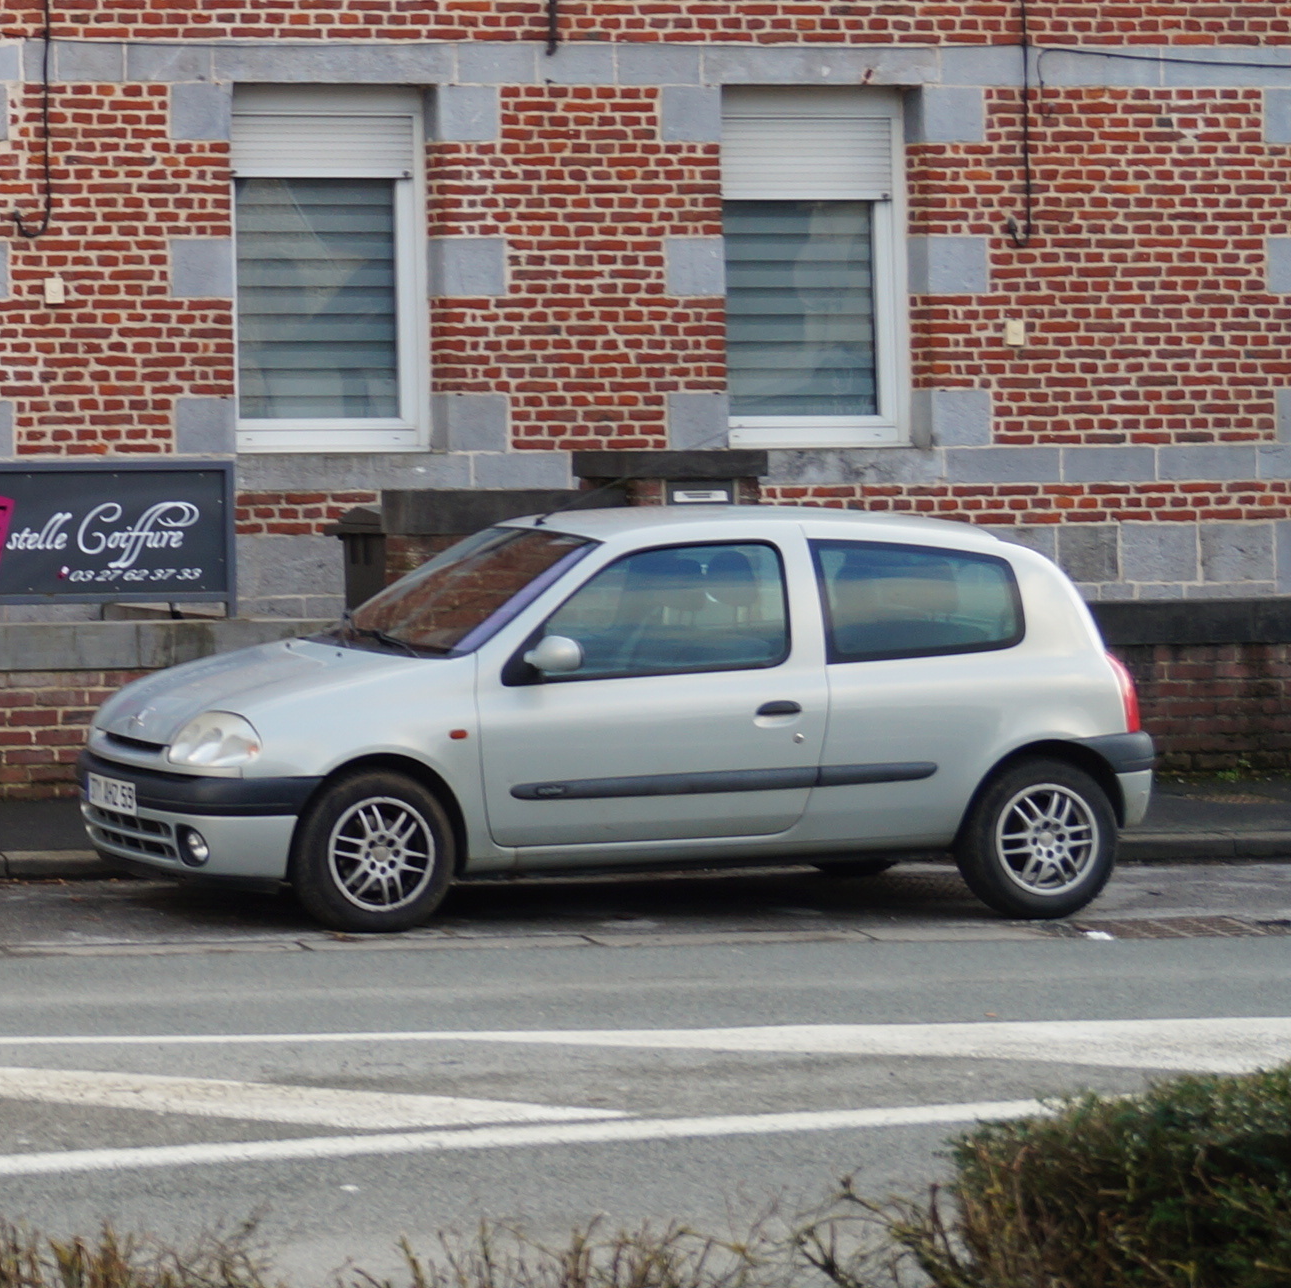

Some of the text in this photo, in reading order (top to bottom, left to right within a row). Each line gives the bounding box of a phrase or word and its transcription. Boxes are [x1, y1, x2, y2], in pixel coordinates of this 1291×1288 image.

[77, 501, 199, 569] Coiffure
[69, 568, 202, 582] 03 27 62 37 33
